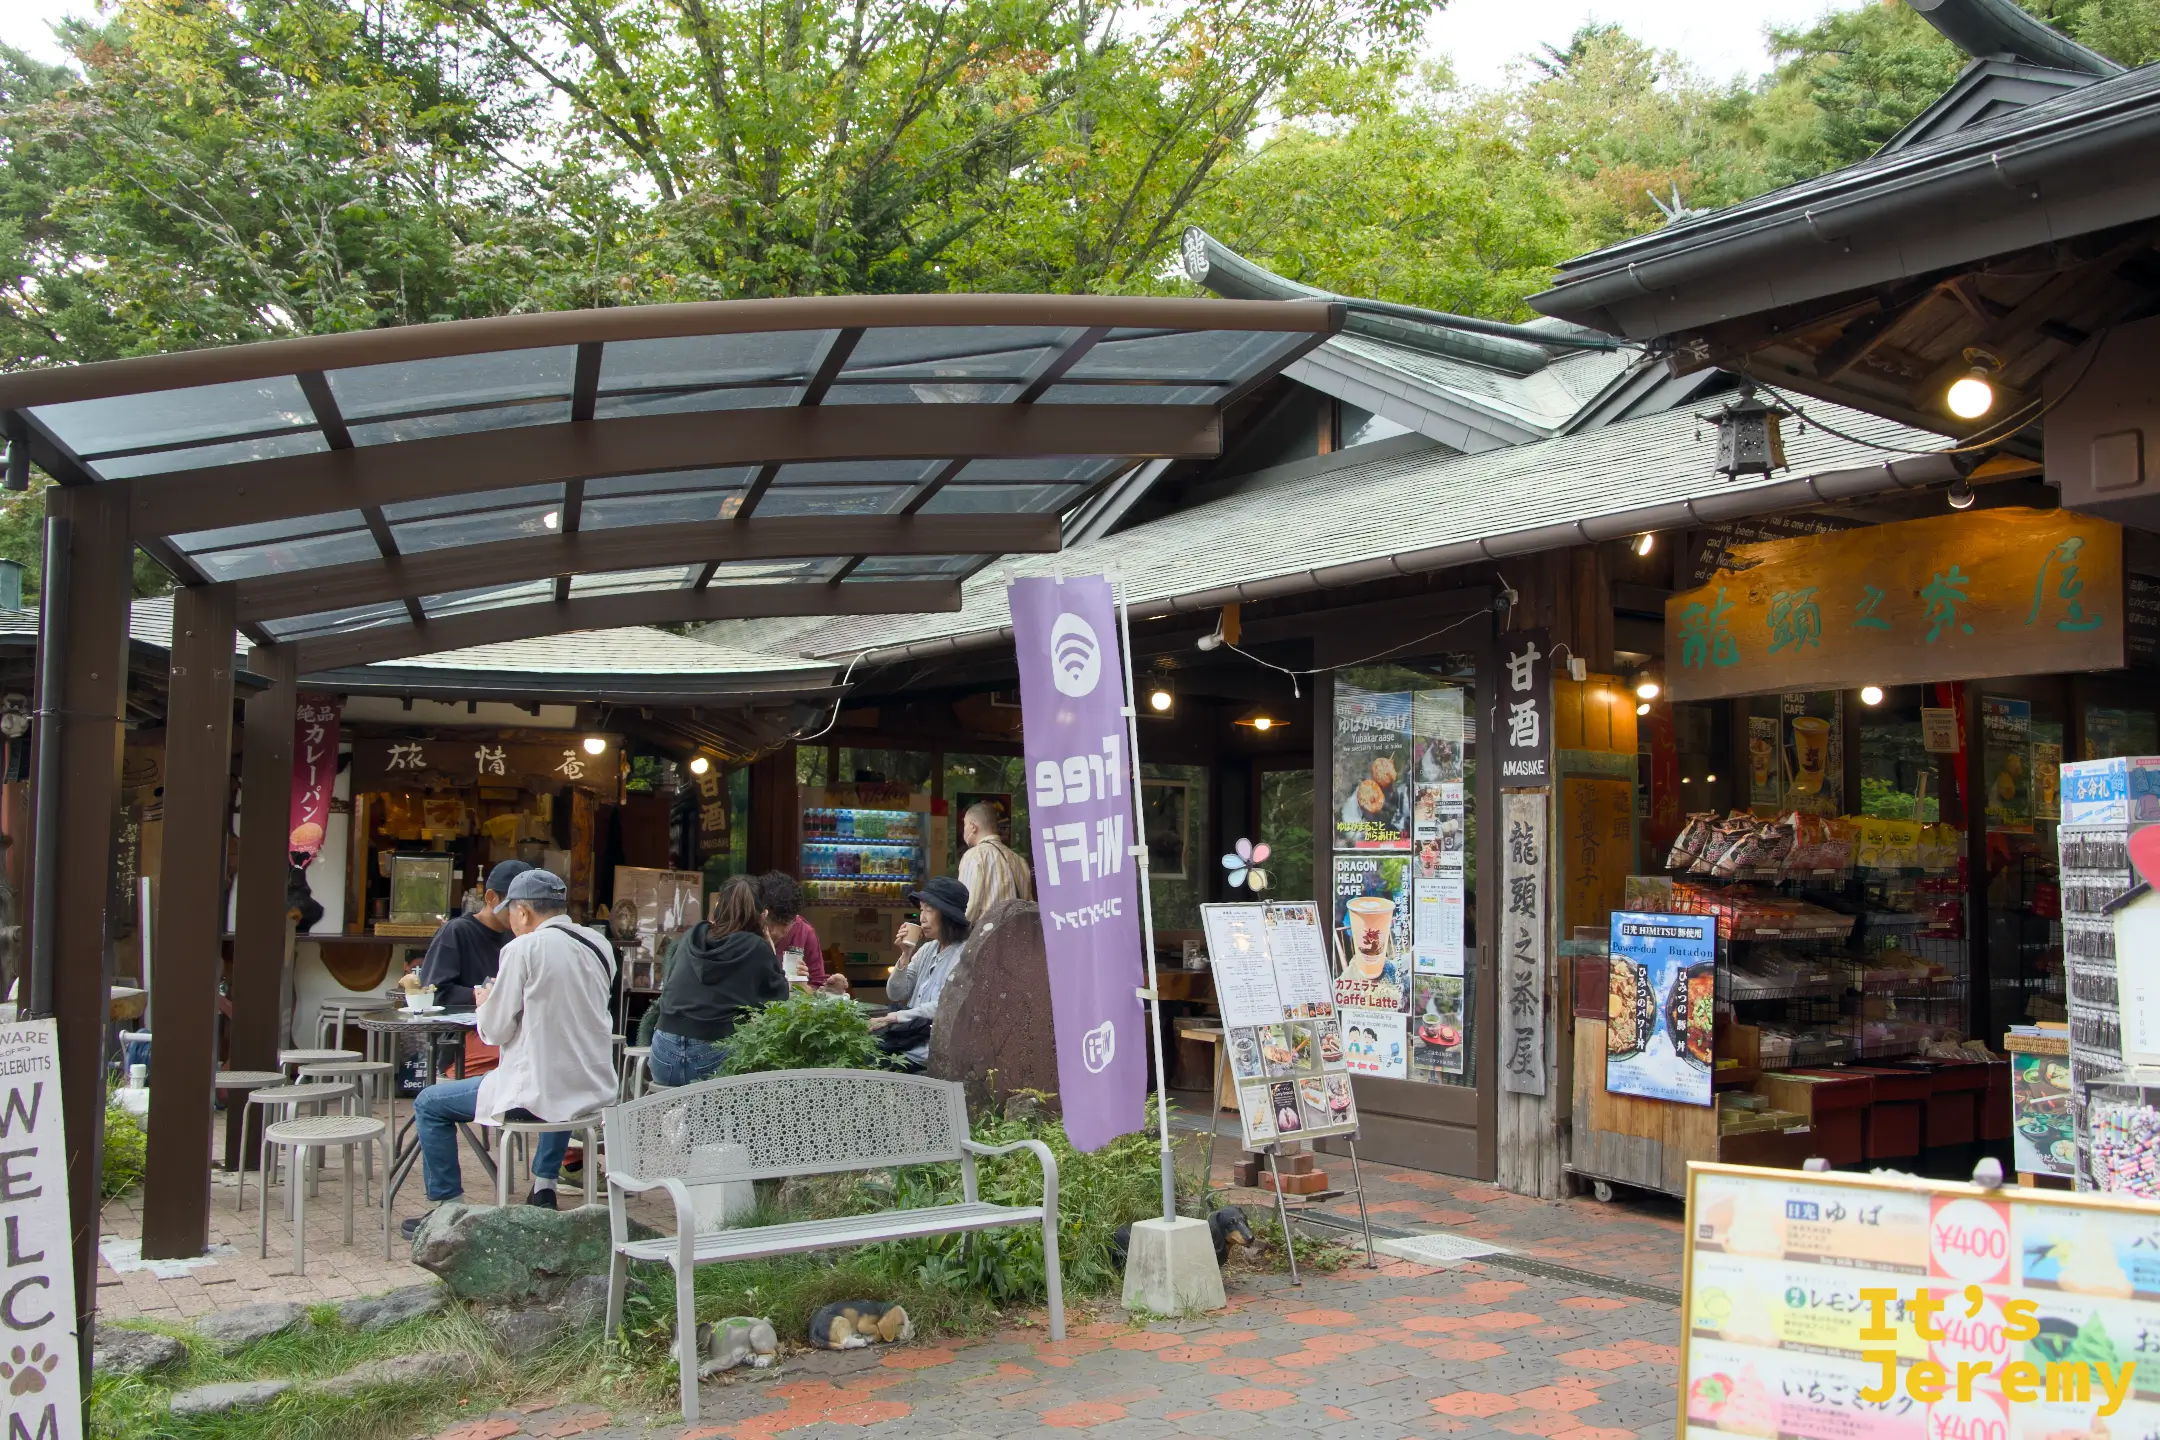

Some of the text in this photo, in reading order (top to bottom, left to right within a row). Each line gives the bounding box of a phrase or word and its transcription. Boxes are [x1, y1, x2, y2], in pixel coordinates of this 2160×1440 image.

[1706, 536, 1721, 549] and
[1677, 535, 2103, 670] 龍頭之茶屋
[1505, 640, 1541, 749] 甘酒
[1783, 693, 1806, 704] HEAD
[296, 704, 335, 723] 絶品
[1783, 704, 1805, 715] CAFE
[1338, 714, 1409, 734] ゆばからあげ
[1351, 733, 1395, 744] Yubakaraage
[384, 740, 587, 781] 旅情庵
[1501, 758, 1546, 778] AMASAKE
[300, 723, 325, 823] カレーパン
[696, 765, 726, 832] 甘酒
[1336, 860, 1378, 872] DRAGON
[1336, 873, 1363, 884] HEAD
[1336, 885, 1362, 896] CAFE
[1623, 924, 1638, 935] 日光
[1638, 927, 1677, 937] HIMITSU
[1504, 819, 1542, 1080] 龍頭之茶屋
[1612, 941, 1657, 954] Power-don
[1669, 945, 1713, 958] Butadon
[1335, 978, 1379, 993] カフェラテ
[1335, 993, 1398, 1009] Caffe Latte
[1636, 966, 1647, 1050] ひみつのパワー丼
[6, 1048, 16, 1057] OF
[403, 1079, 428, 1089] Speci
[1825, 1199, 1884, 1226] ゆば
[1935, 1223, 2006, 1260] ¥400
[1809, 1288, 1917, 1324] レモン乳
